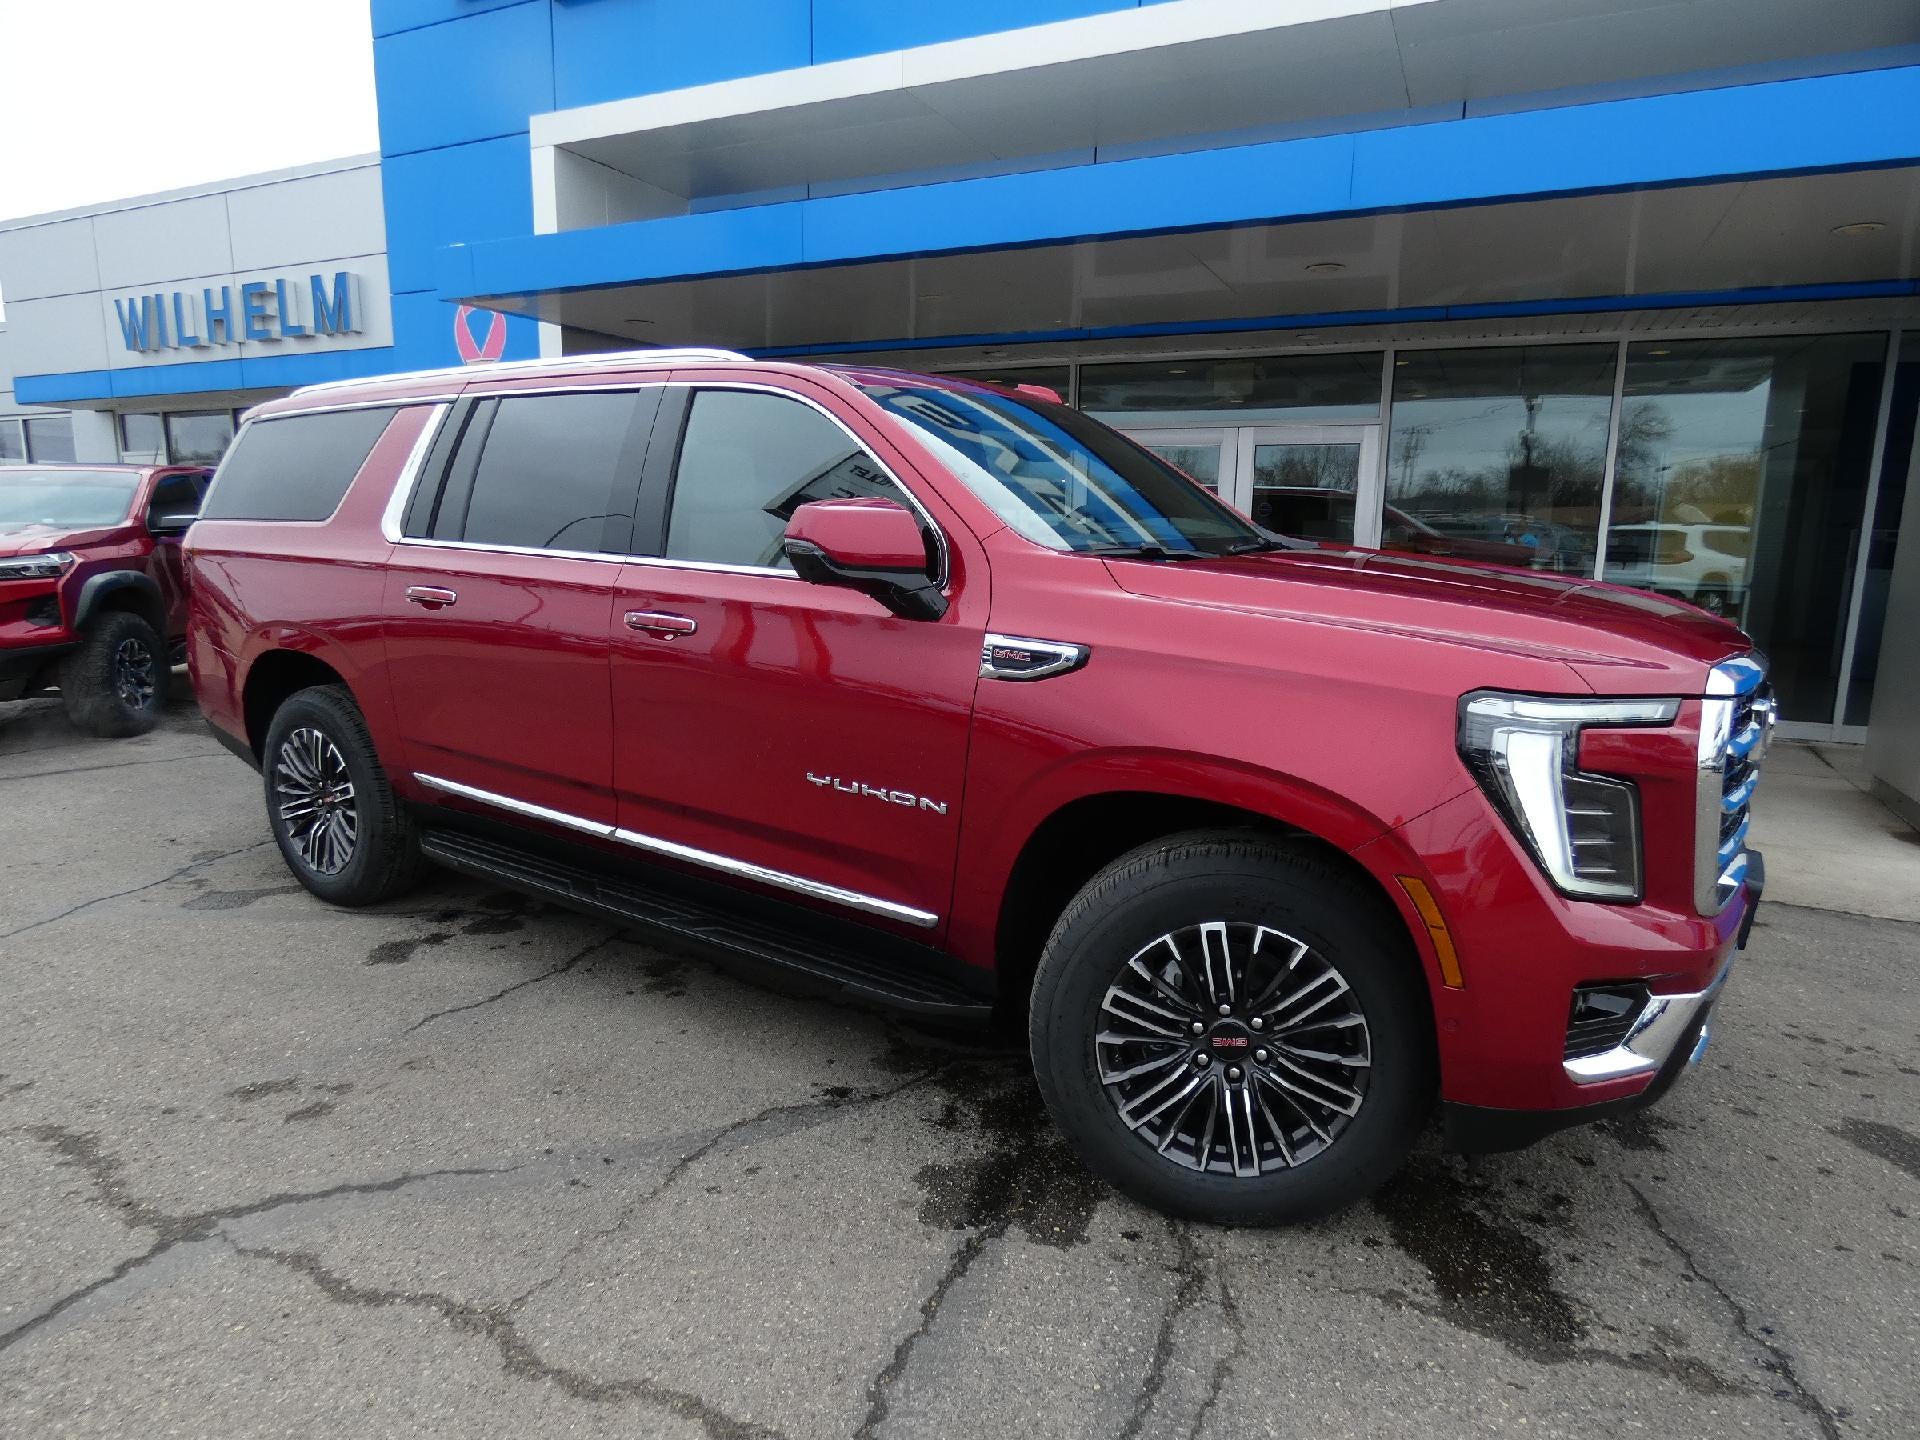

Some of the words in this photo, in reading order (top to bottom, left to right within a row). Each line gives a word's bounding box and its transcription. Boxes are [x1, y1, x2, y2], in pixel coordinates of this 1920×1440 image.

[114, 272, 358, 352] WILHELM
[993, 648, 1031, 662] GMC
[806, 772, 947, 815] YUKON
